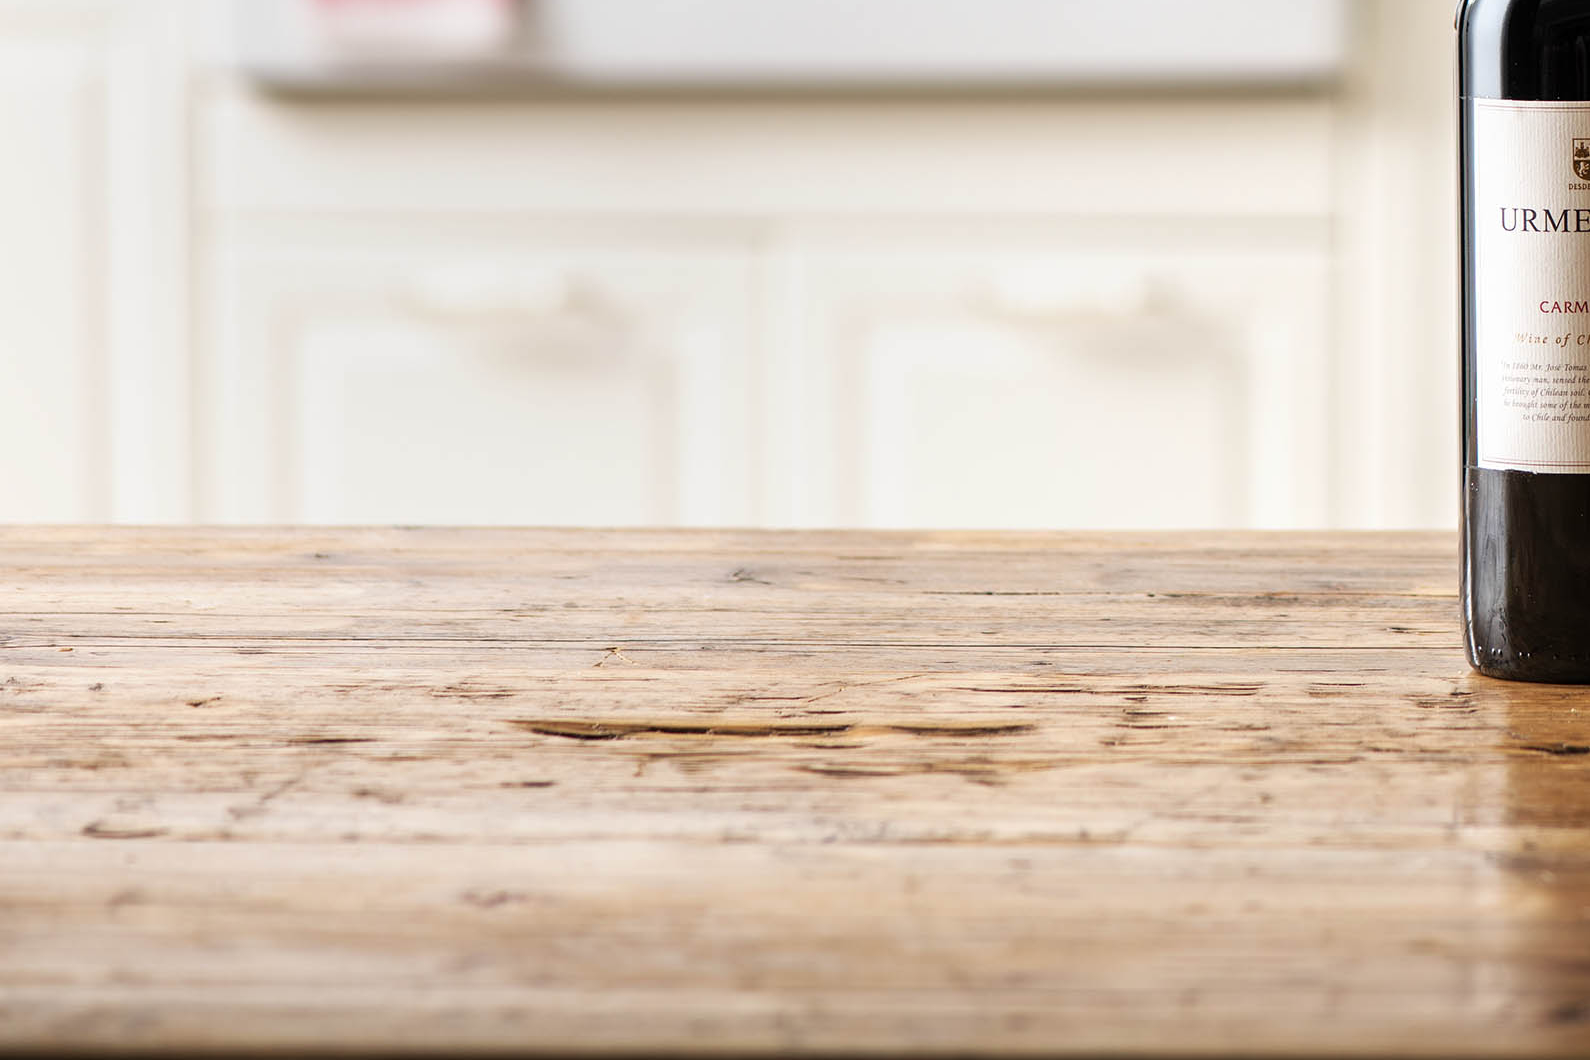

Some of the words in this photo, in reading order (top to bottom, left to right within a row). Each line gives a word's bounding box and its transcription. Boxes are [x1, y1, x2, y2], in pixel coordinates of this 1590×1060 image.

[1514, 332, 1548, 344] Wine
[1555, 333, 1571, 348] of
[1552, 375, 1576, 384] sensed
[1578, 376, 1590, 384] the
[1531, 387, 1539, 398] of
[1540, 388, 1568, 397] Chilean
[1570, 388, 1585, 397] soil.
[1559, 400, 1568, 411] of
[1570, 400, 1582, 409] the
[1531, 413, 1550, 422] Chile
[1552, 413, 1566, 422] and
